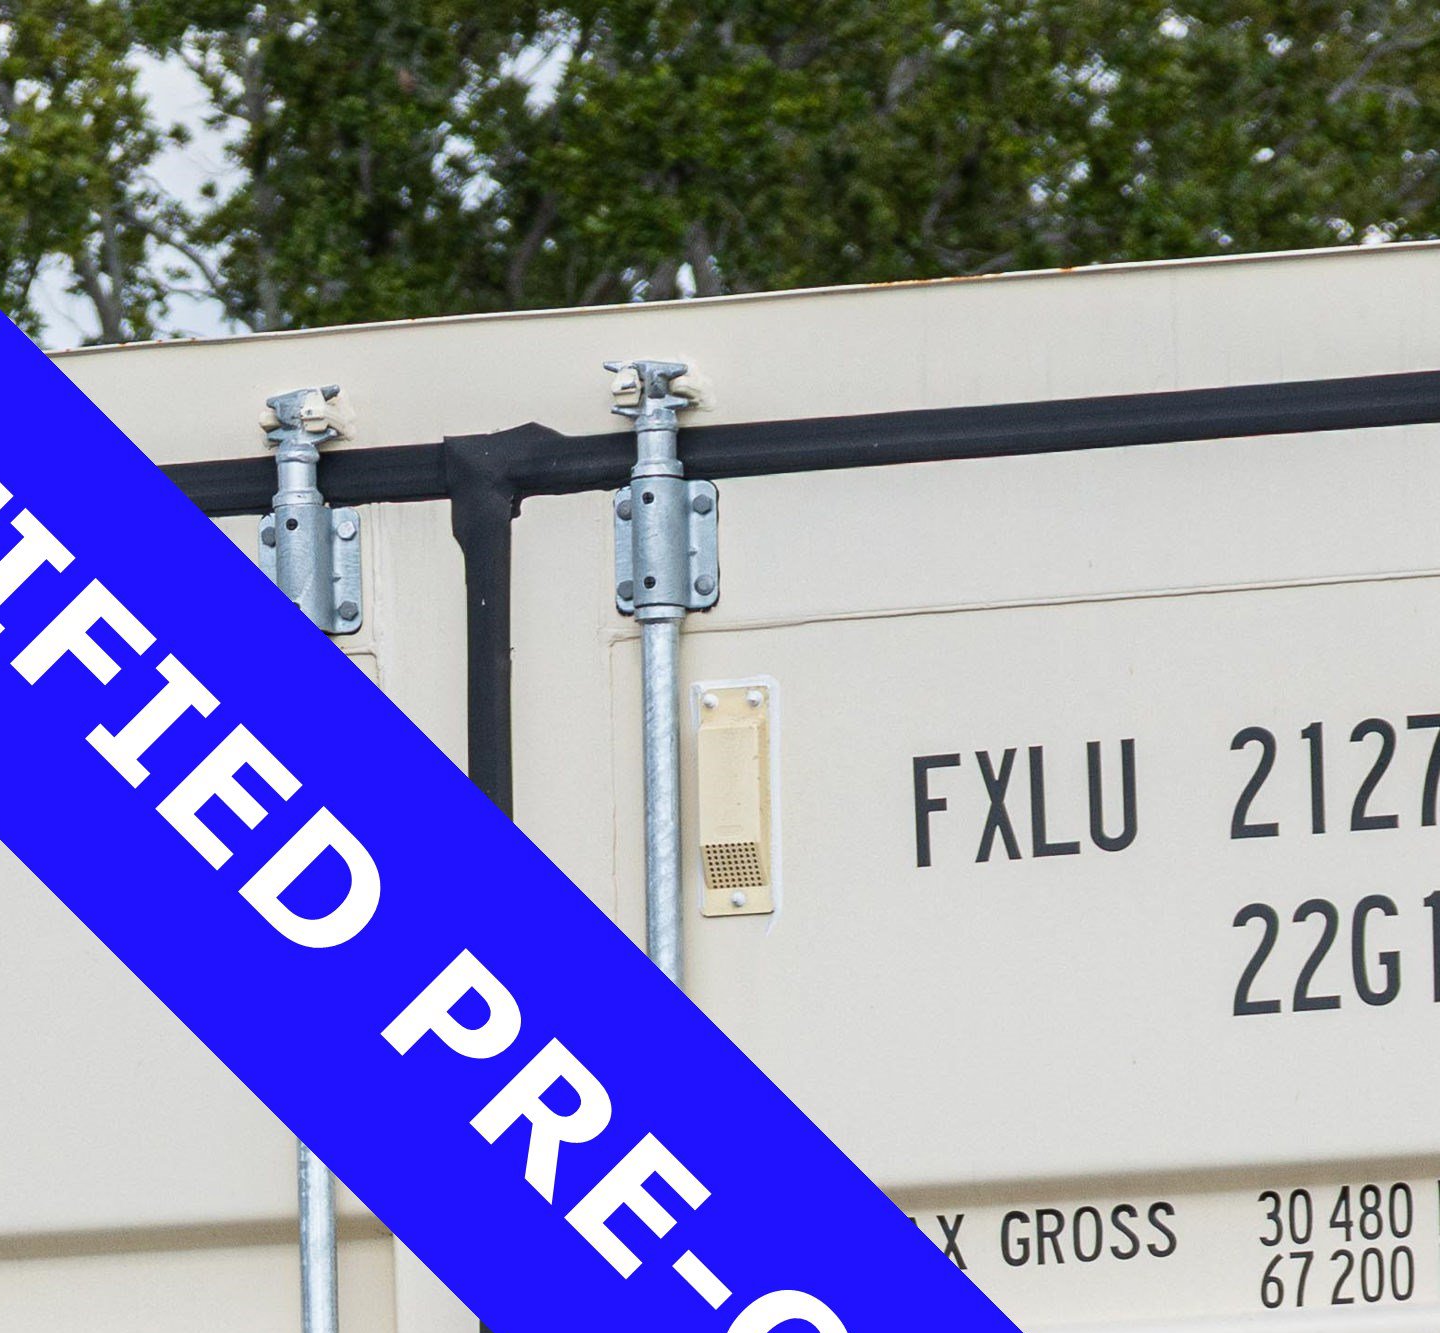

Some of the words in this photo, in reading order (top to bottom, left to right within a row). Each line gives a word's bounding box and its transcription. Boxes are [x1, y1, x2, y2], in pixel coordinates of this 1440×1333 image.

[913, 738, 1138, 867] FXLU
[1232, 890, 1440, 1017] 22G1
[1001, 1201, 1178, 1267] GROSS
